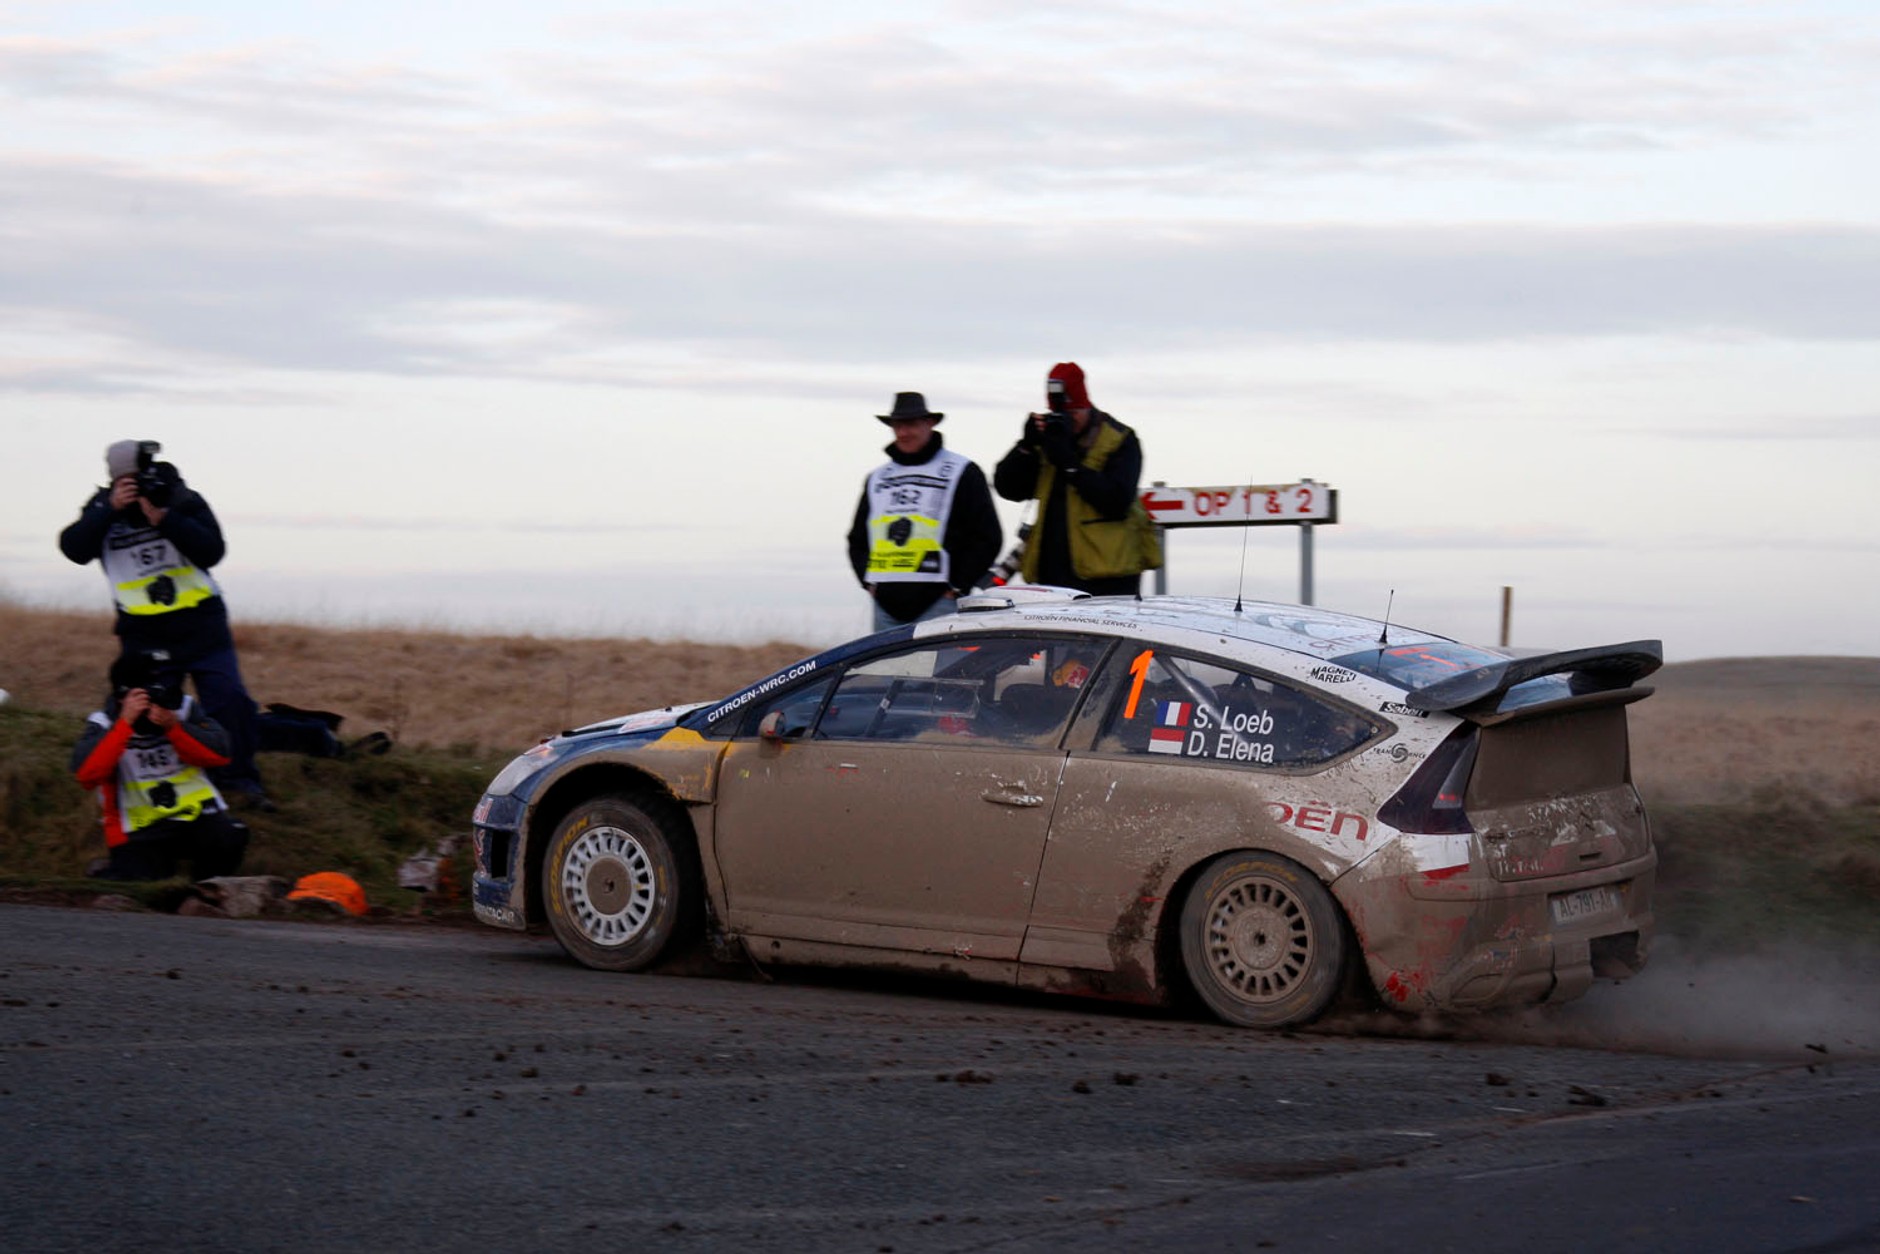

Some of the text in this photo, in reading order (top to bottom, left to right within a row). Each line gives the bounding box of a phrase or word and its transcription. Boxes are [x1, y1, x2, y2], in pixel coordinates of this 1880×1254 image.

[1194, 488, 1312, 516] OP 1 & 2
[1059, 615, 1100, 625] FINANCIAL
[1101, 619, 1138, 630] SERVICES
[1123, 649, 1154, 719] 1
[1311, 665, 1357, 680] MAGNETI
[1311, 668, 1356, 684] MARELLI
[707, 660, 817, 723] CITROEN-WRC.COM
[1193, 703, 1275, 735] S. Loeb
[1187, 731, 1275, 764] D. Elena
